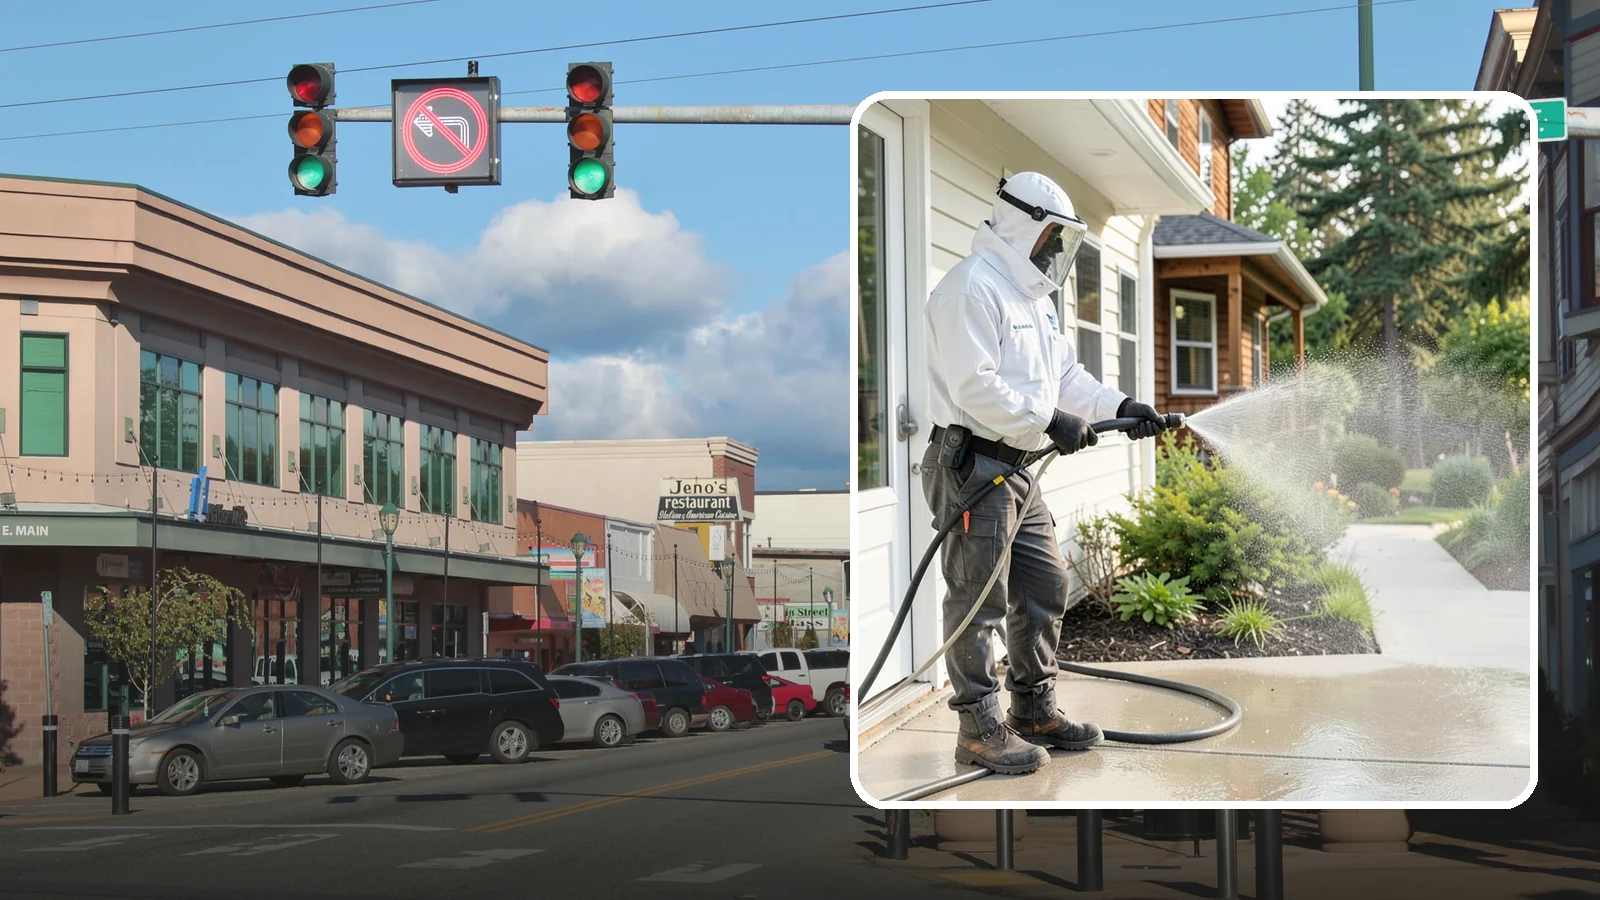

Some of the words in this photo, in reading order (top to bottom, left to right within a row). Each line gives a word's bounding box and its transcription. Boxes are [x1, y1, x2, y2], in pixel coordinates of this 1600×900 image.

[669, 480, 728, 495] Jeno's
[665, 496, 731, 509] restaurant
[659, 510, 681, 520] Italian
[686, 510, 714, 519] American
[715, 509, 738, 519] Cuisine
[2, 525, 13, 536] E.
[15, 525, 49, 536] MAIN
[797, 607, 828, 617] Street
